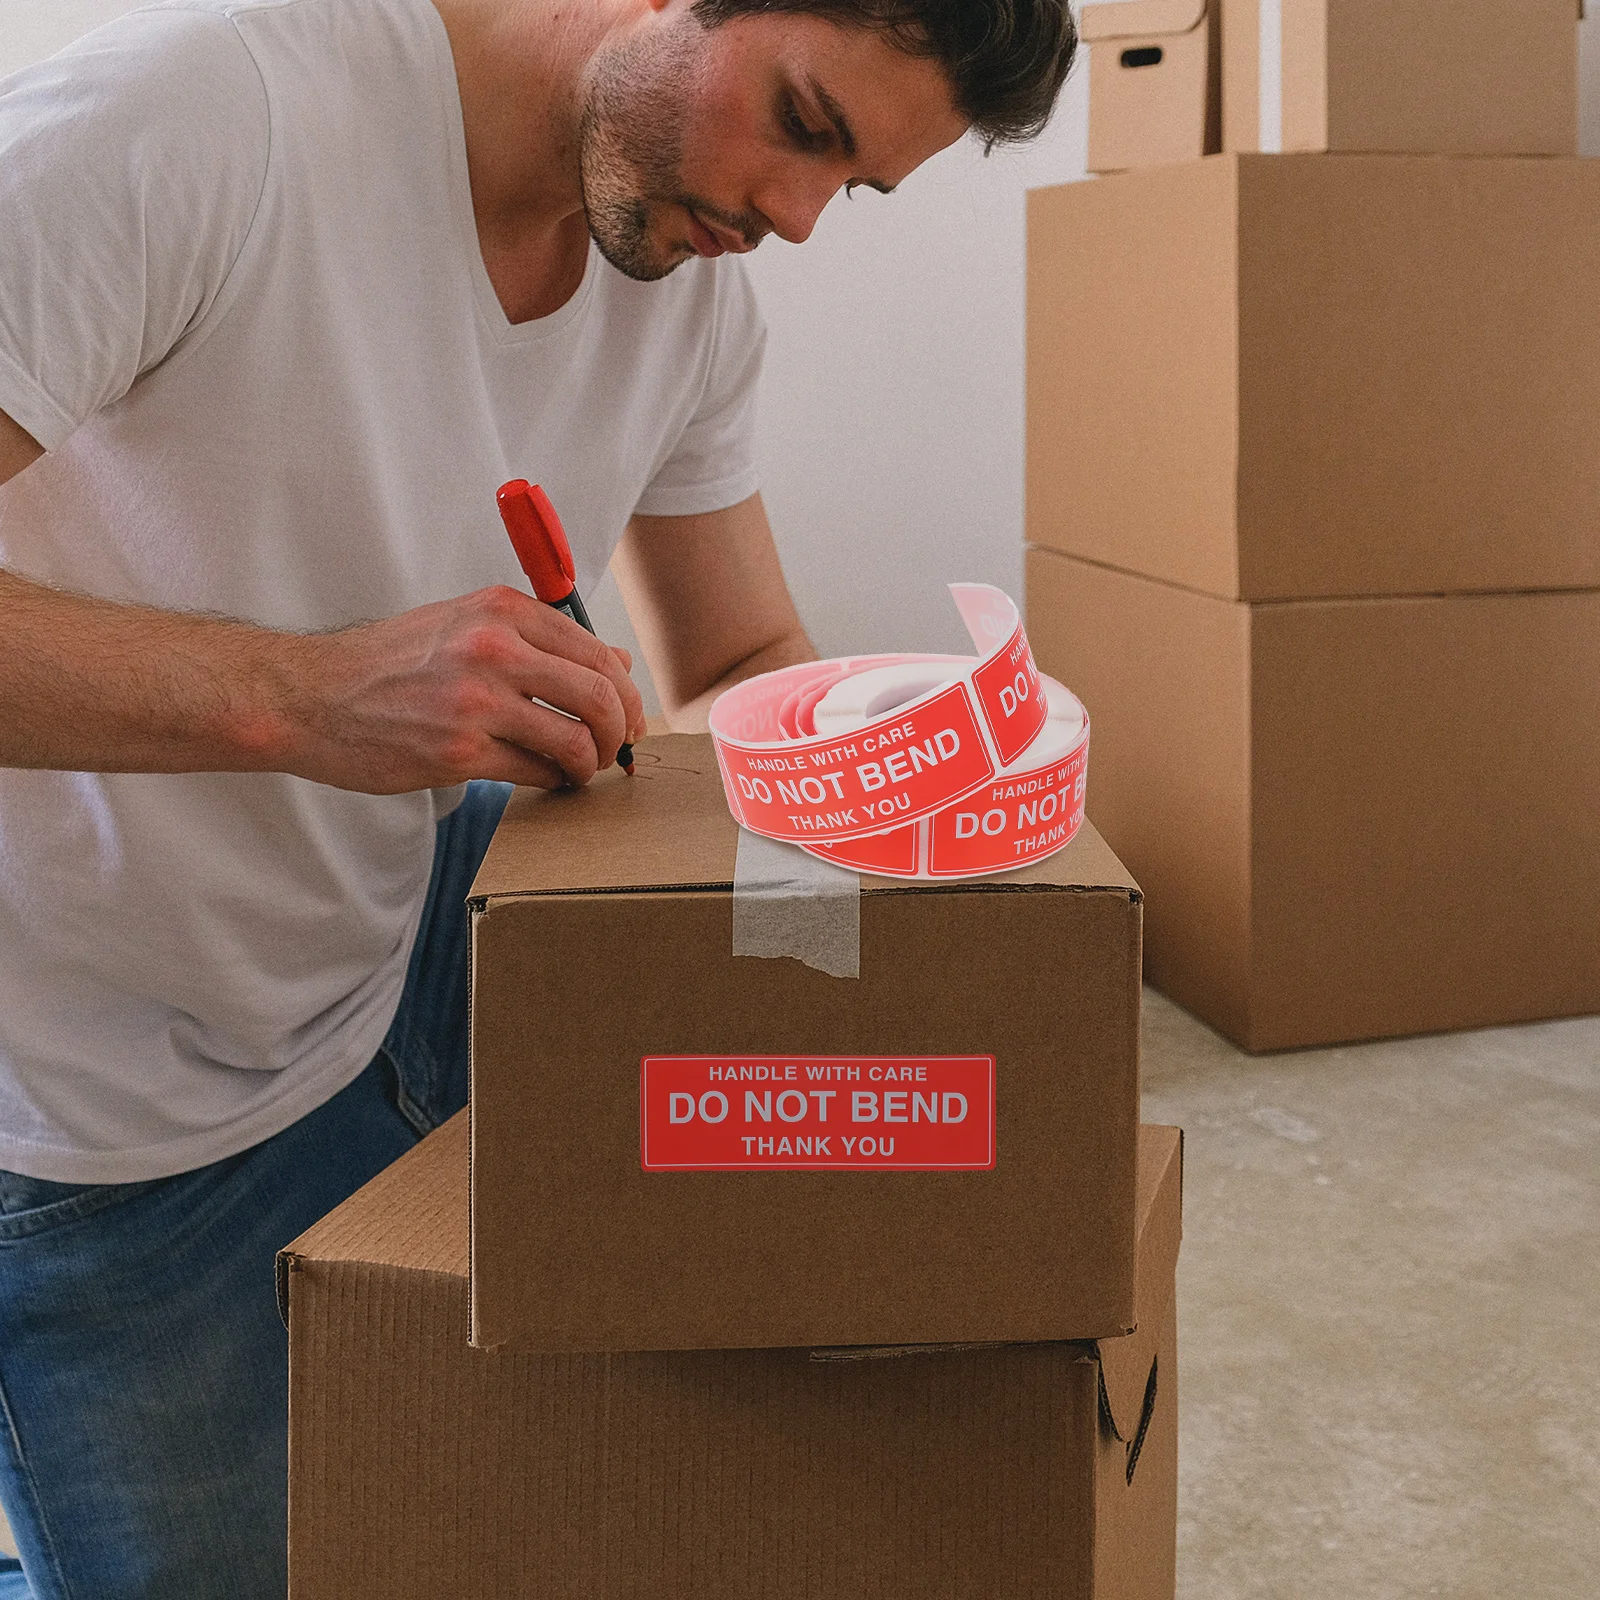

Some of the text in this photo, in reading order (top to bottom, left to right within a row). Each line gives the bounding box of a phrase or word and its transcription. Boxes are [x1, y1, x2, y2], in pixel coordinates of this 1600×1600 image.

[999, 671, 1029, 718] DO
[737, 728, 960, 805] DO NOT BEND
[746, 721, 916, 772] HANDLE WITH CARE
[992, 759, 1080, 801] HANDLE WITH
[788, 792, 911, 830] THANK YOU
[955, 808, 1007, 839] DO
[1018, 784, 1071, 830] NOT
[1013, 820, 1066, 855] THANK
[709, 1066, 927, 1082] HANDLE WITH CARE
[669, 1089, 968, 1125] DO NOT BEND
[741, 1136, 895, 1157] THANK YOU
